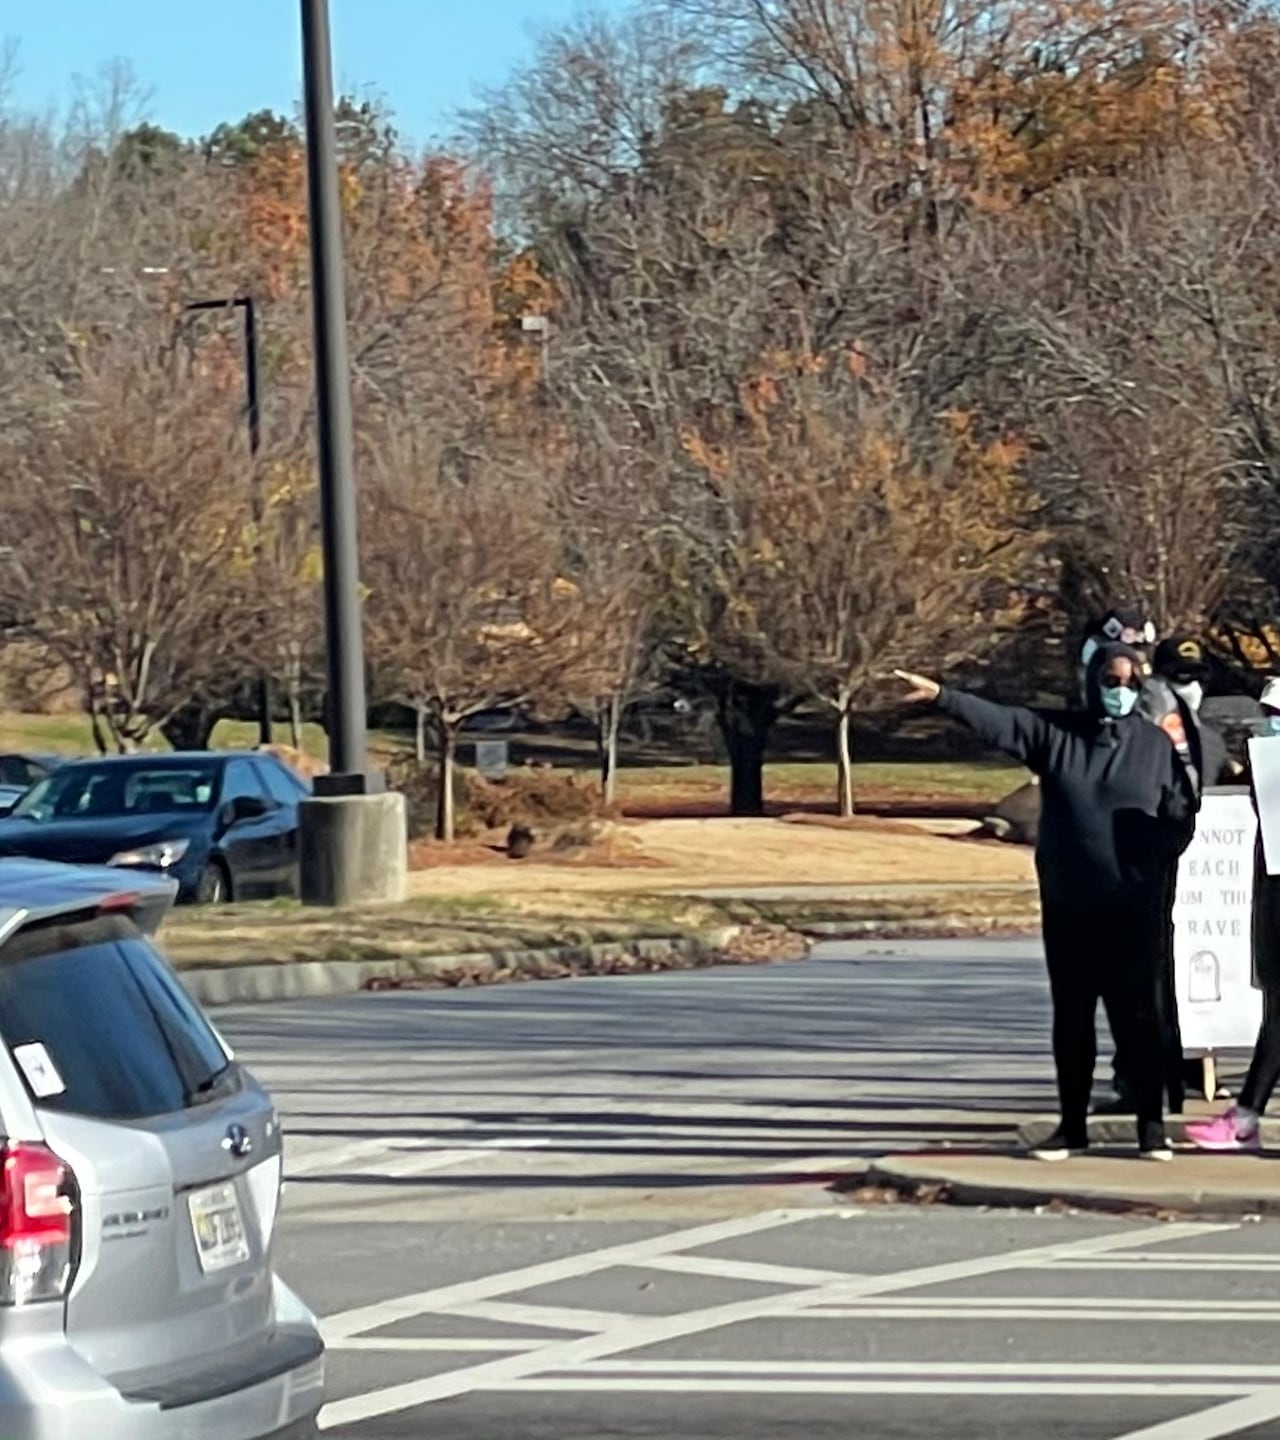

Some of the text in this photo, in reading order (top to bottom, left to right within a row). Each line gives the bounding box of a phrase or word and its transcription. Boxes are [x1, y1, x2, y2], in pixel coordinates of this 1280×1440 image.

[1200, 828, 1246, 846] NNOT
[1189, 860, 1240, 877] EACH
[1187, 919, 1242, 937] RAVE
